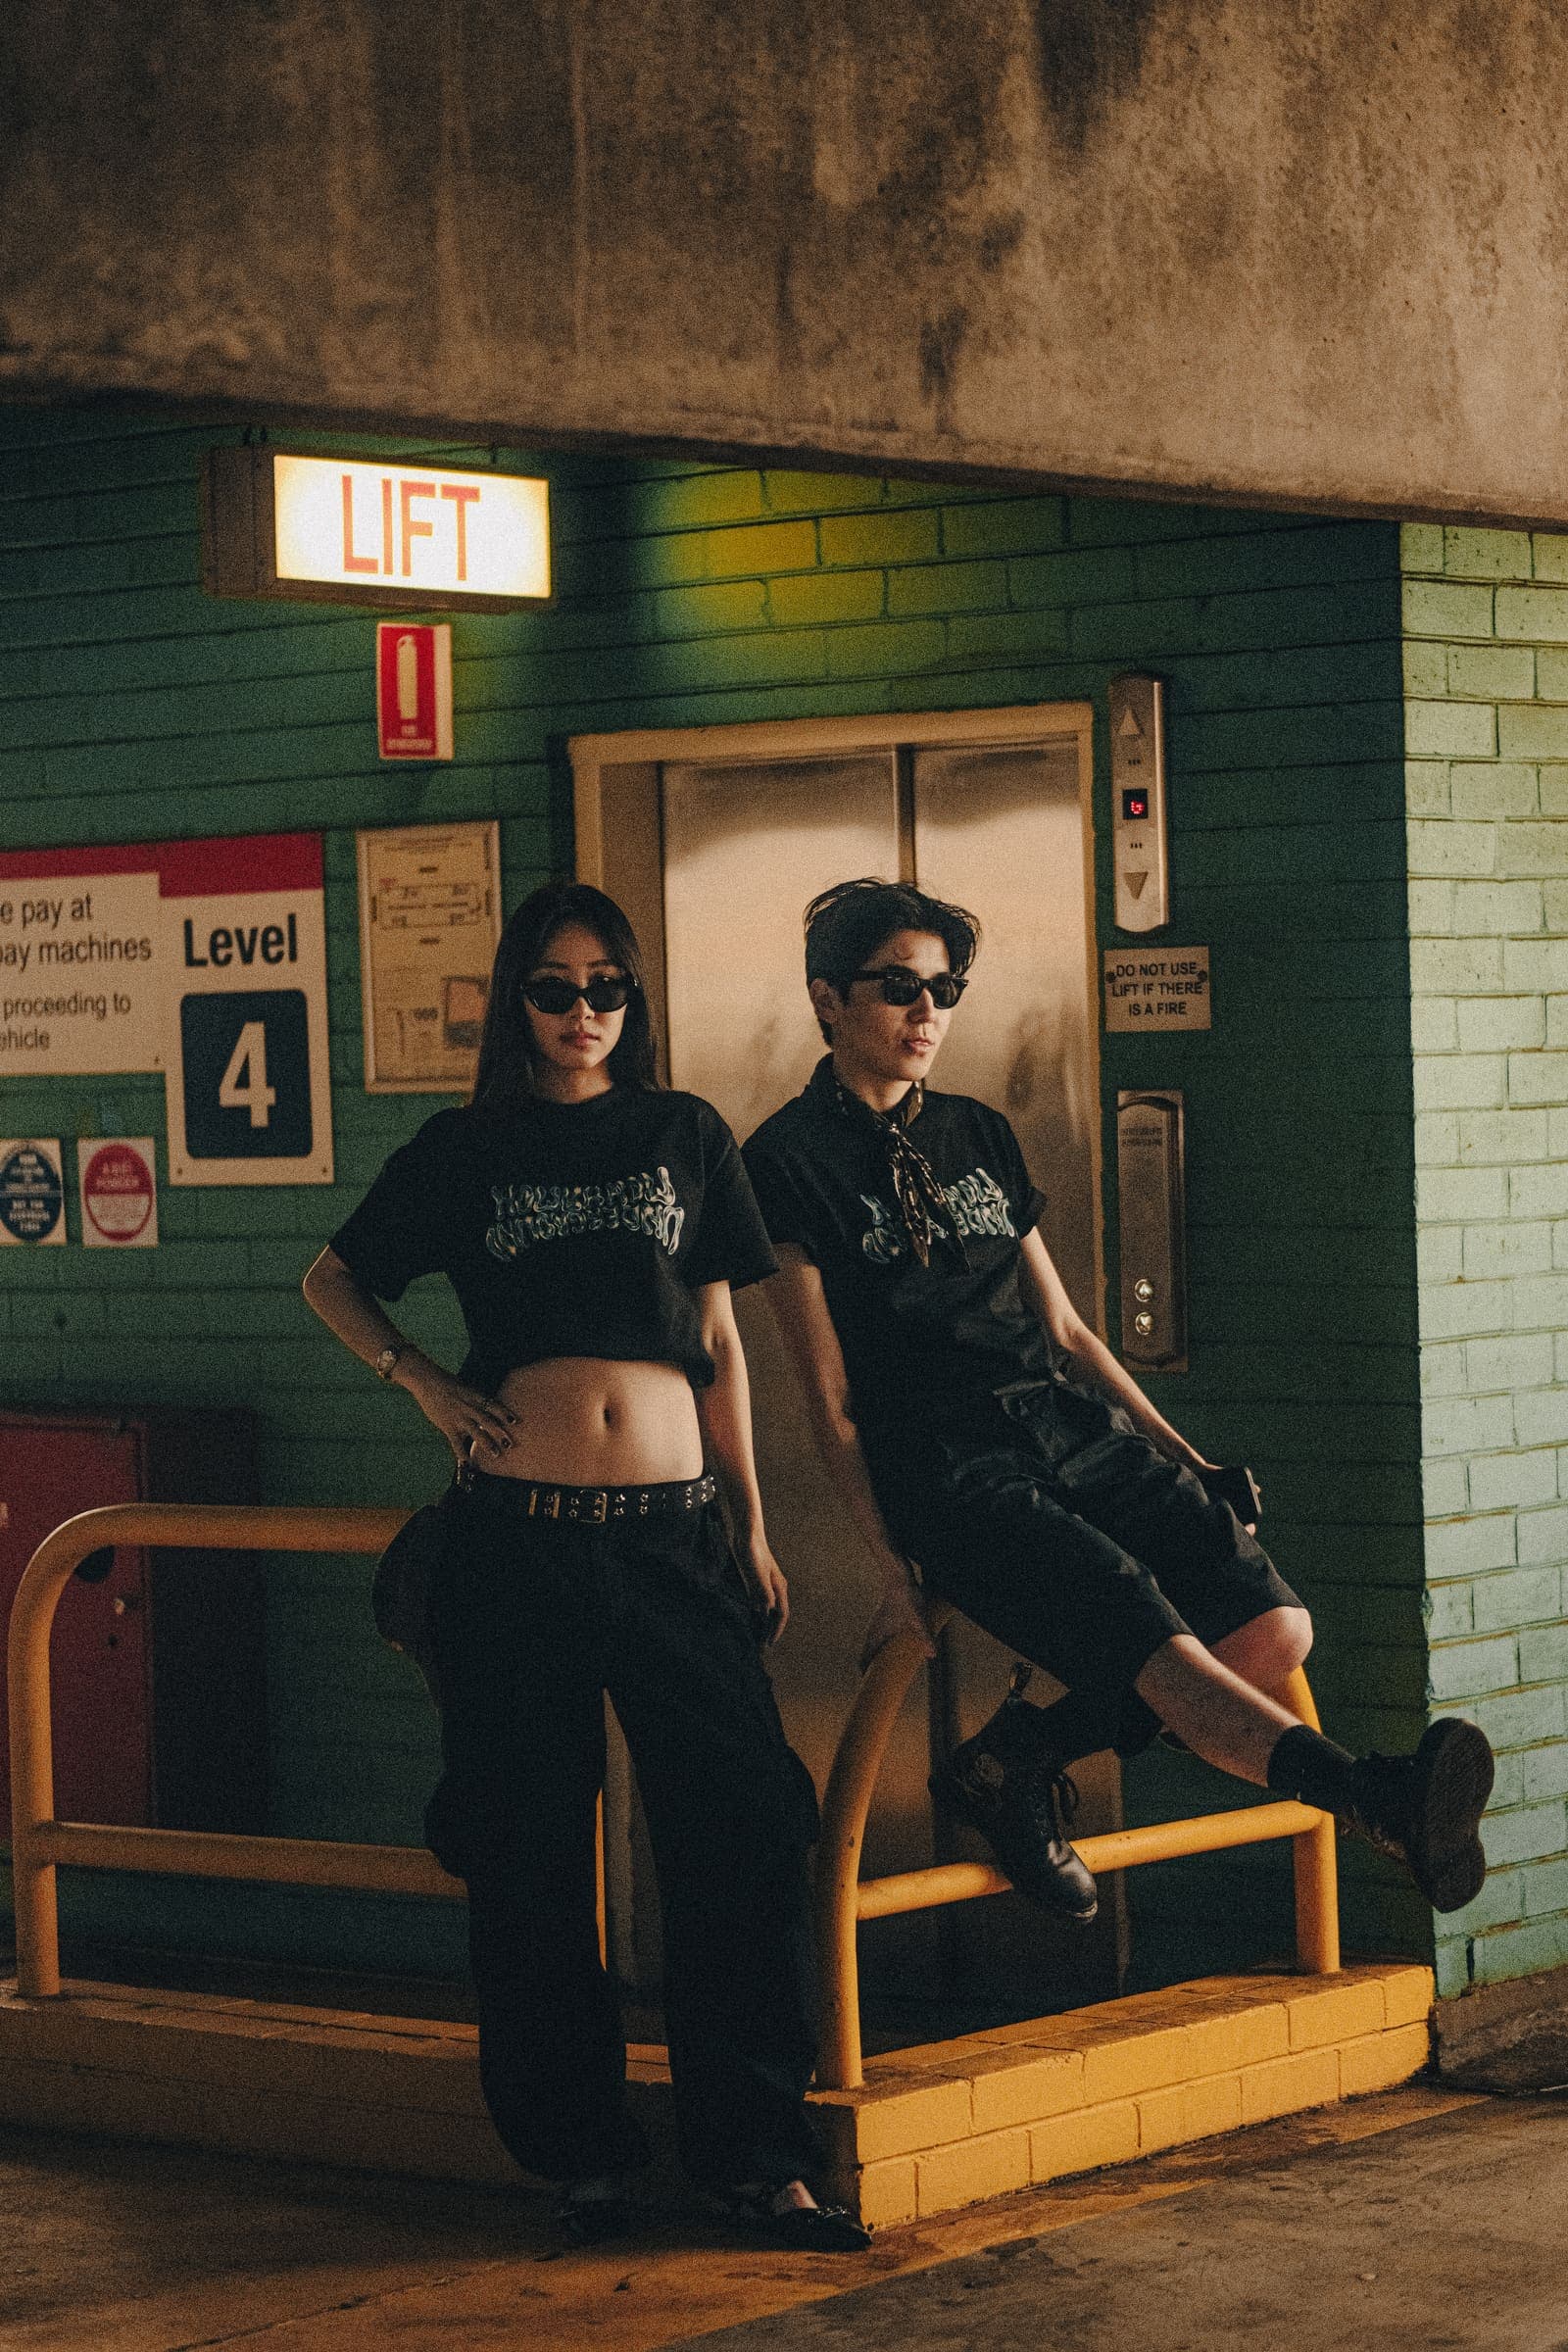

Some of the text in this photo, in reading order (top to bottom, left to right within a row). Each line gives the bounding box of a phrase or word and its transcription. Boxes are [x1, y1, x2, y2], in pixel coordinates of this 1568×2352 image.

[342, 474, 480, 581] LIFT
[22, 899, 63, 930] pay
[71, 894, 92, 921] at
[38, 933, 151, 964] machines
[184, 913, 298, 968] Level
[1116, 962, 1197, 977] DO NOT USE
[1111, 981, 1203, 997] LIFT IF THERE
[3, 992, 131, 1021] proceeding to
[1129, 1002, 1187, 1016] IS A FIRE
[220, 1021, 275, 1128] 4
